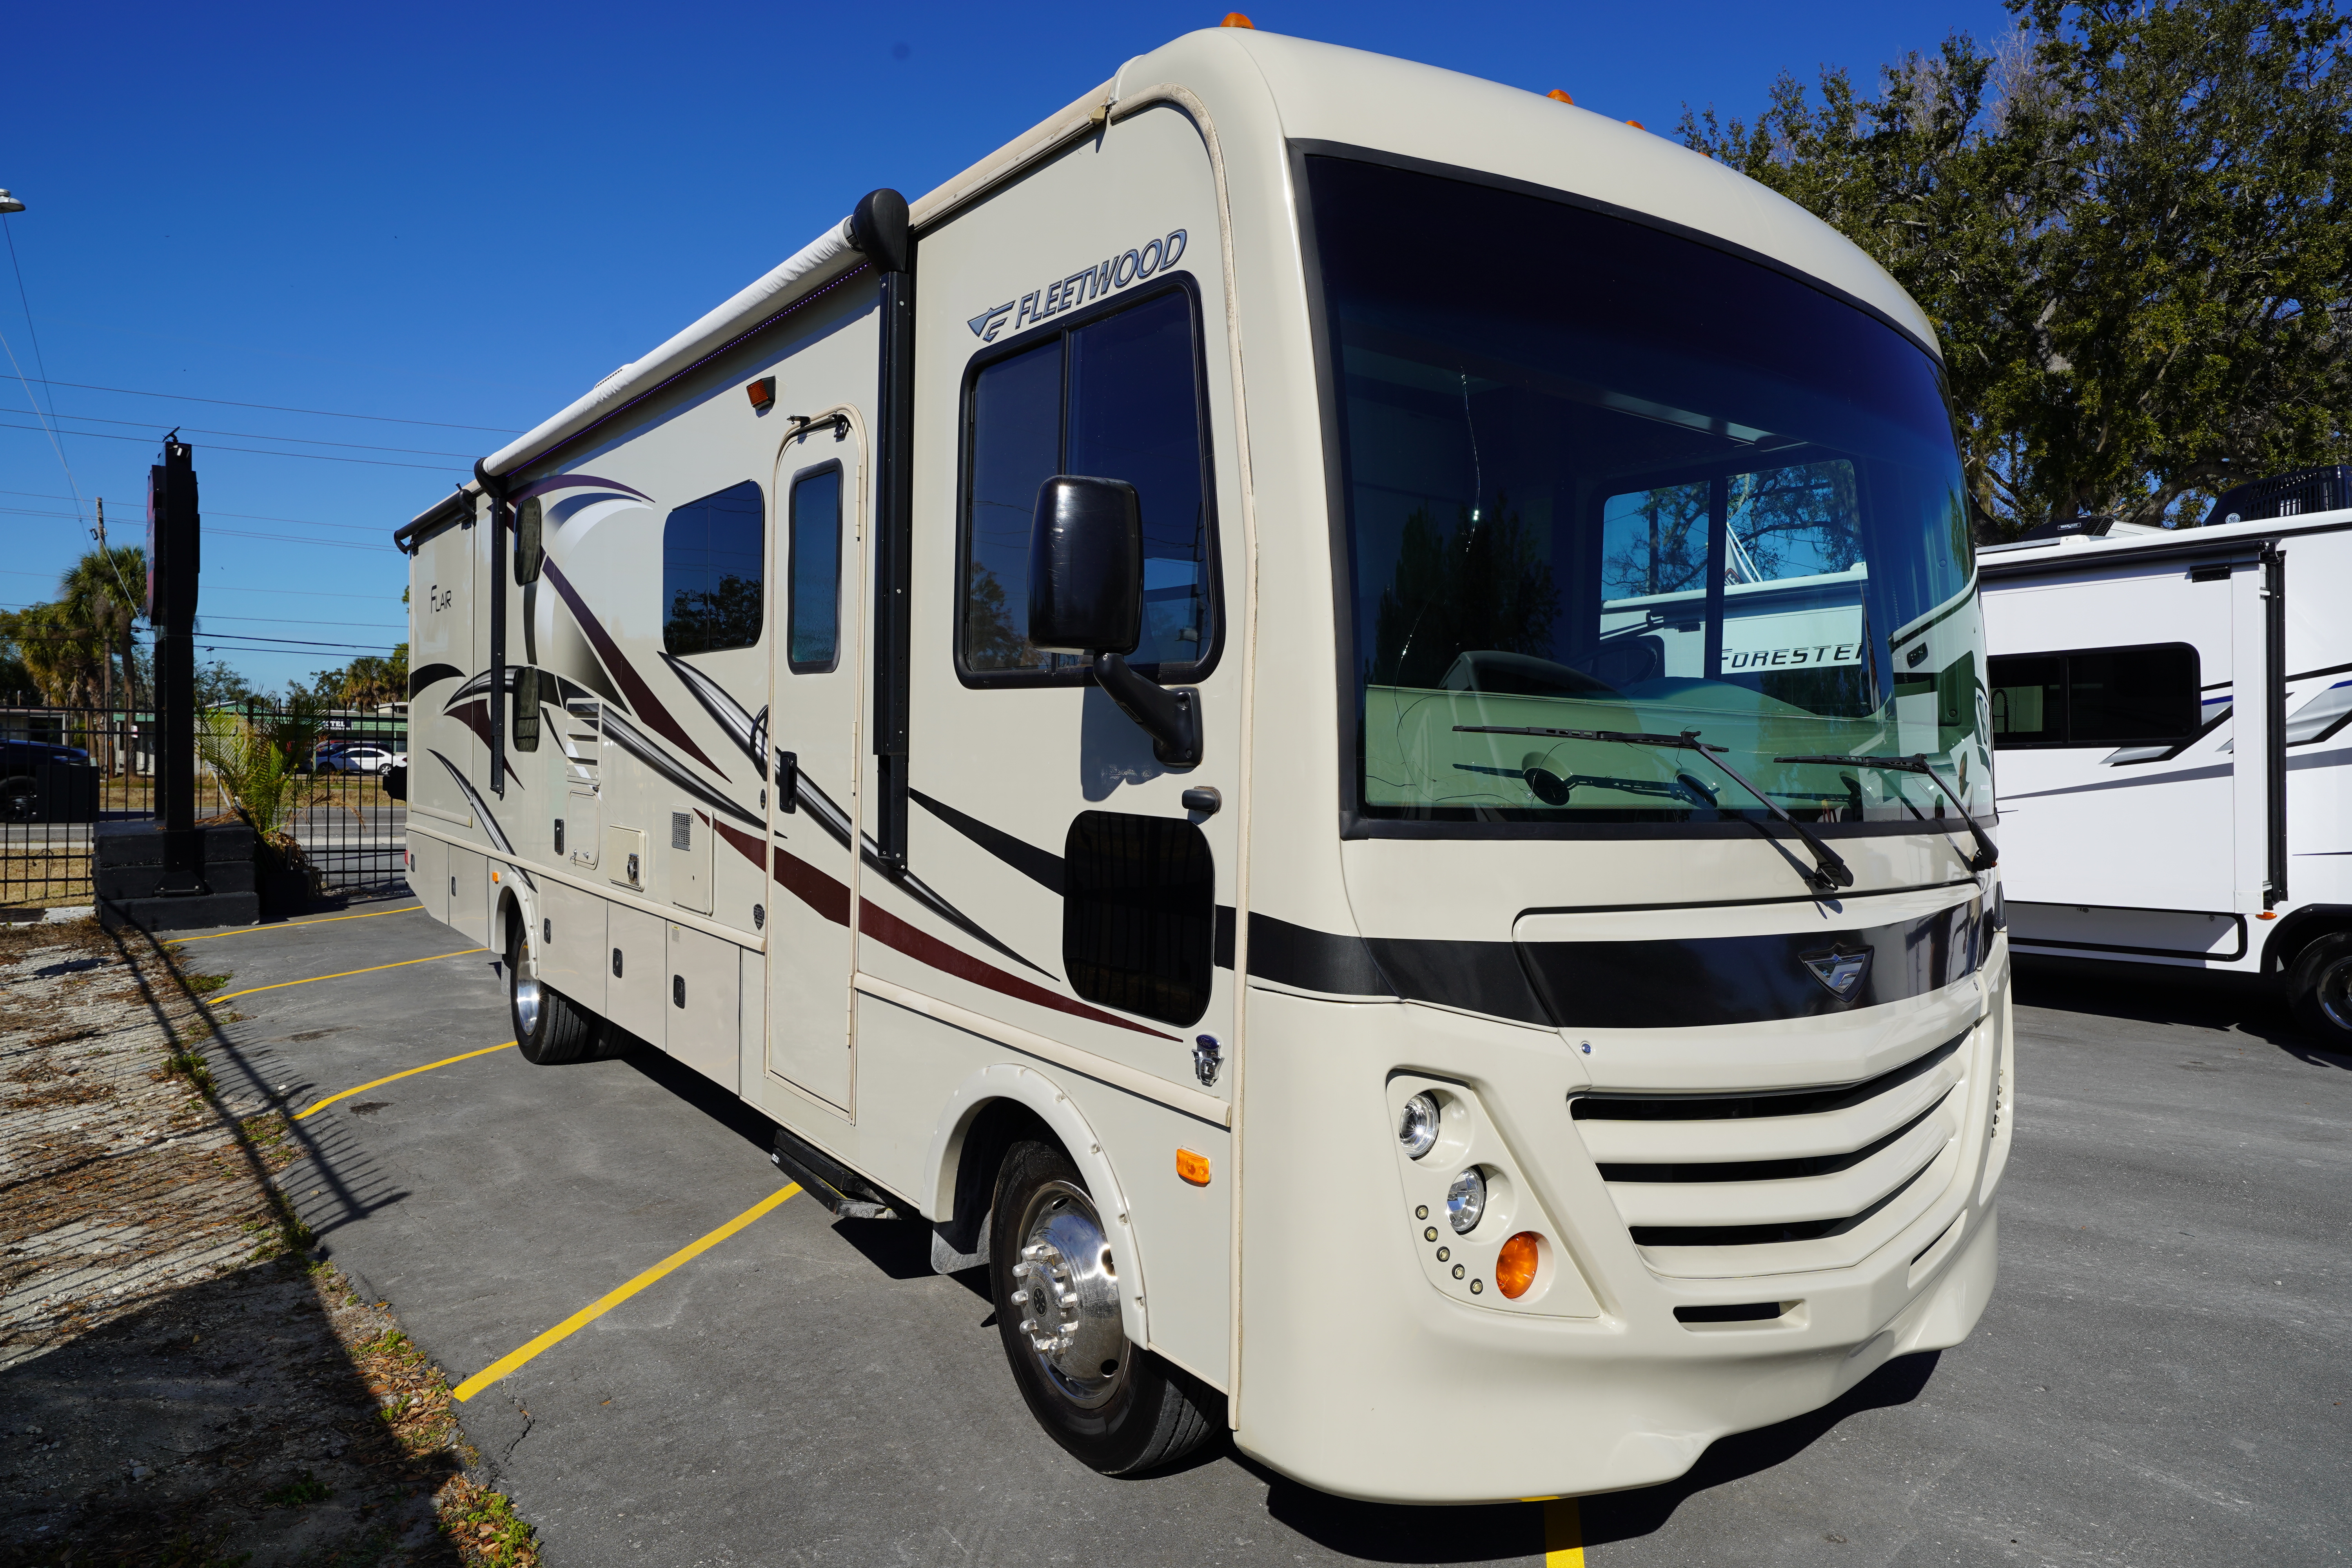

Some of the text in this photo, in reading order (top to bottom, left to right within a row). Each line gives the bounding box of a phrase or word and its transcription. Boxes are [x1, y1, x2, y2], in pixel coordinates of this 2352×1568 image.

[1015, 229, 1187, 330] FLEETWOOD
[431, 584, 451, 614] FLAIR
[1199, 1037, 1212, 1047] Ford
